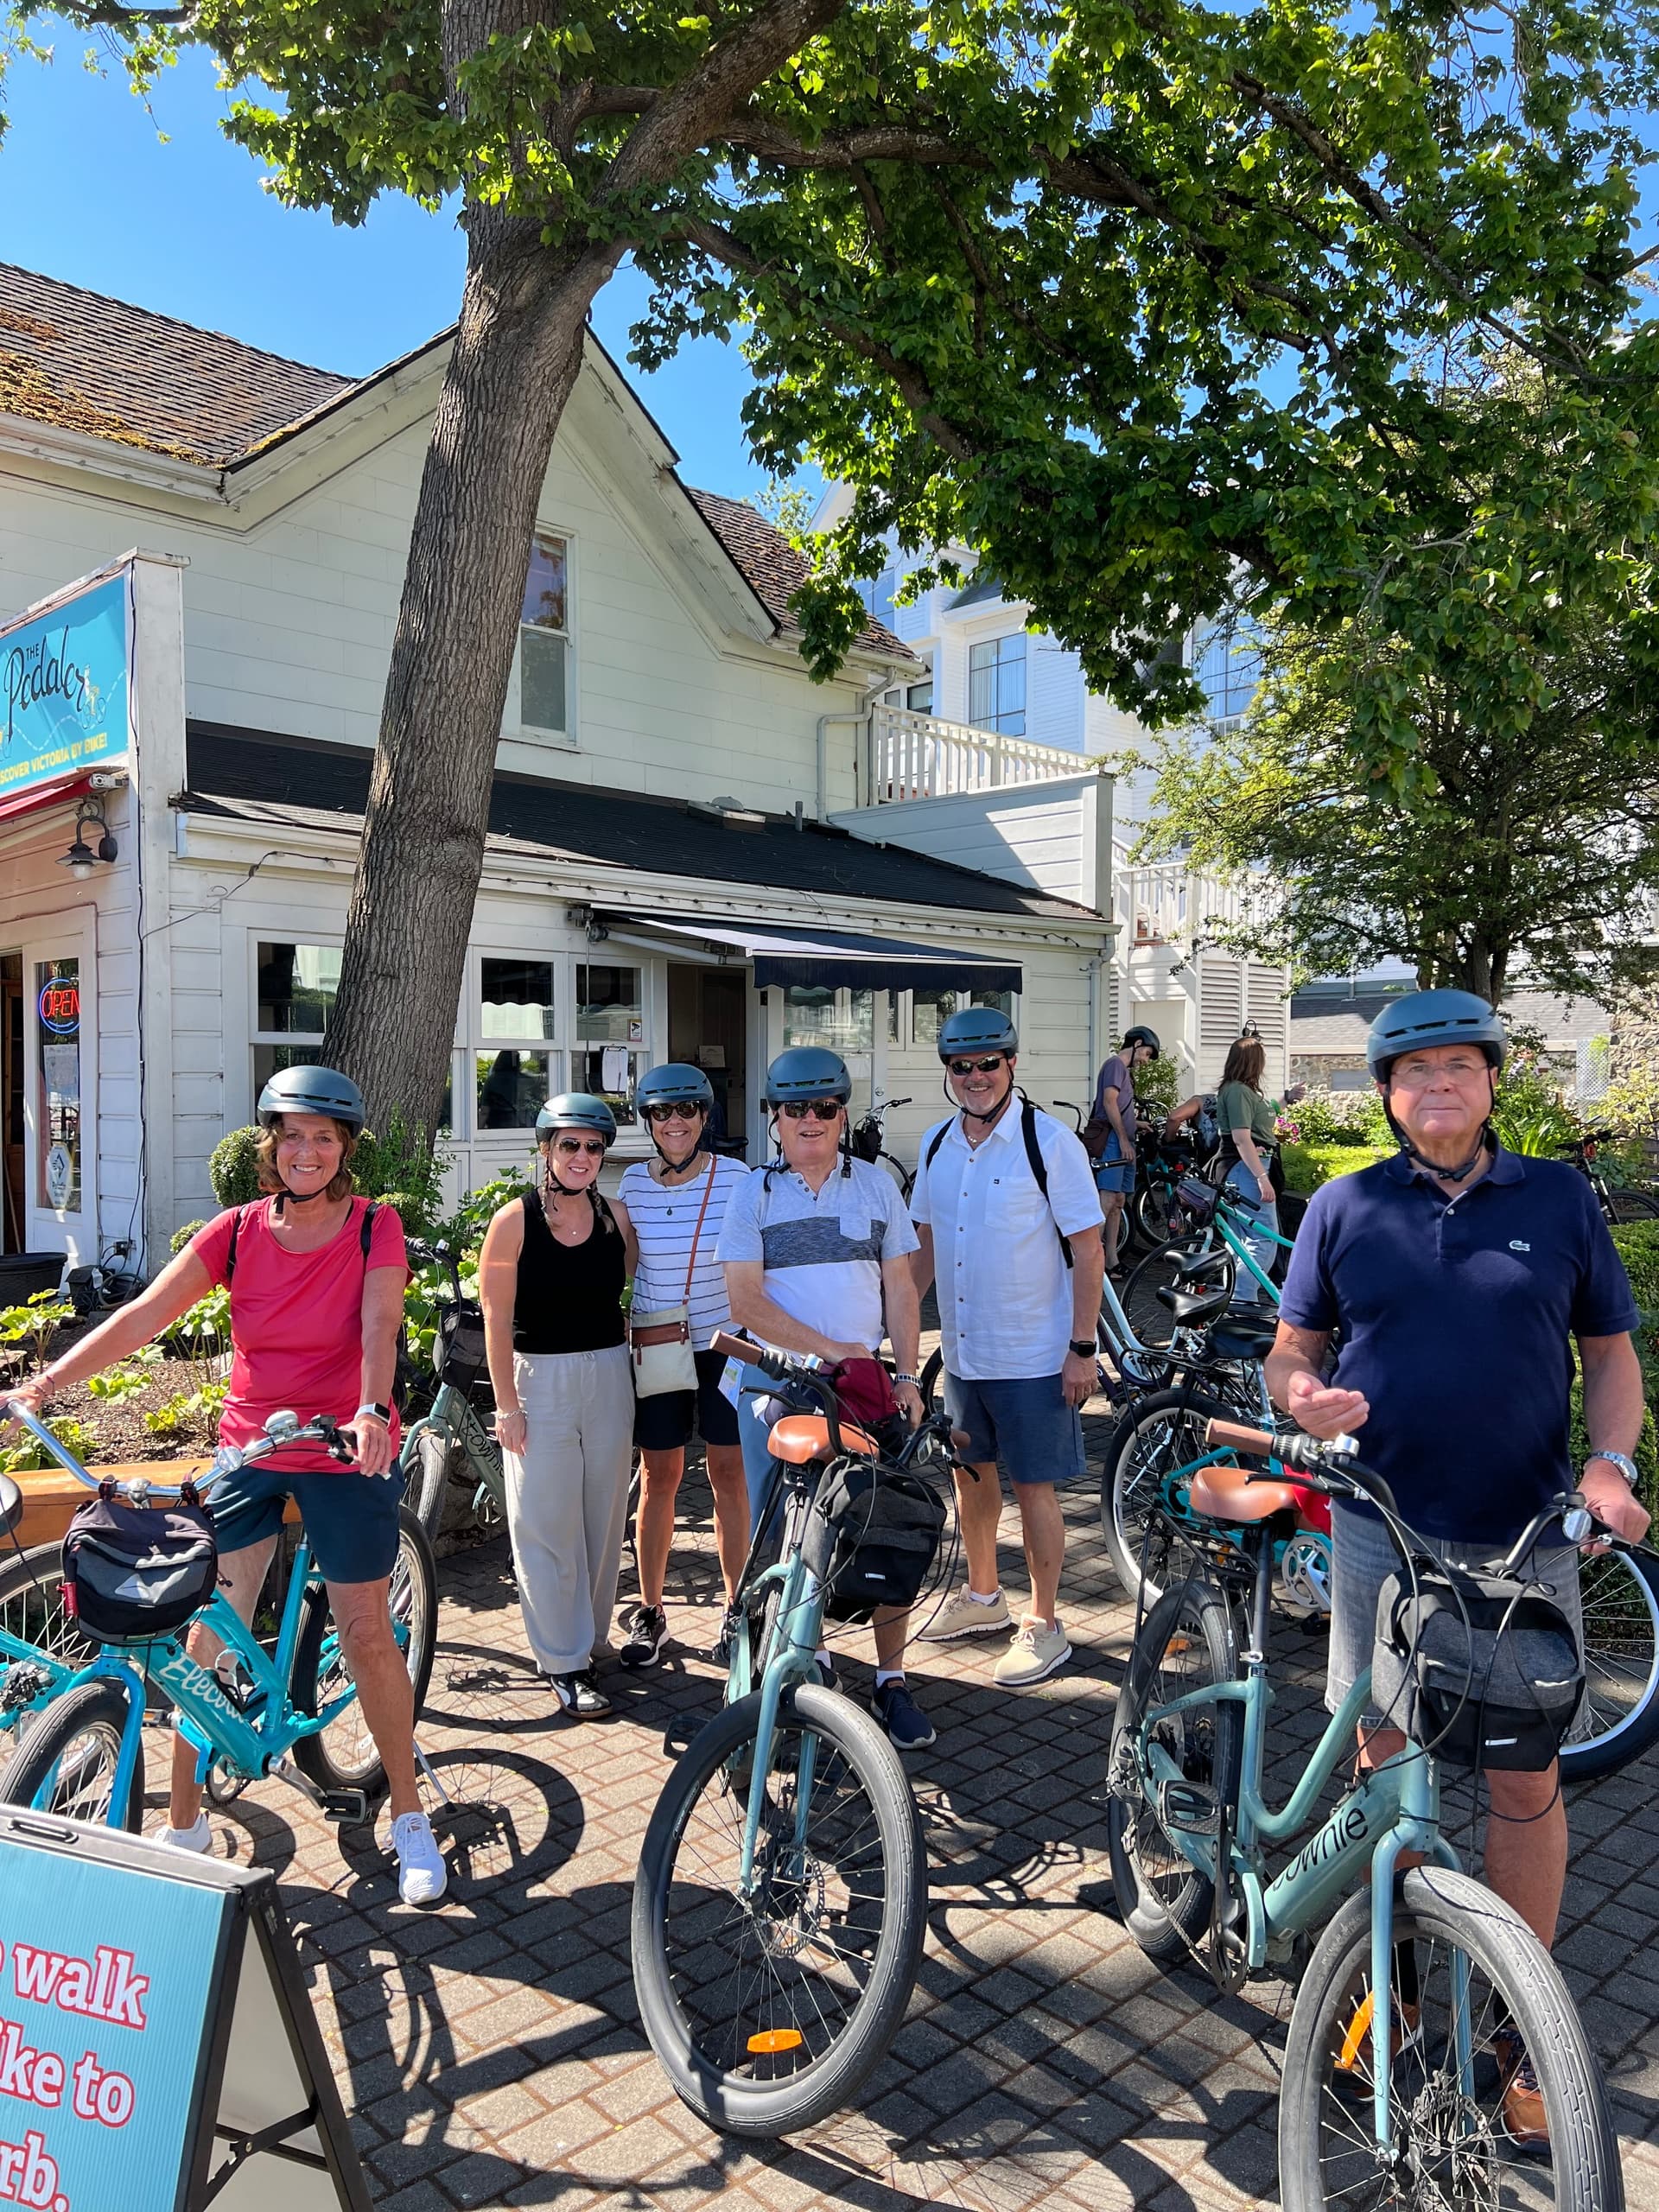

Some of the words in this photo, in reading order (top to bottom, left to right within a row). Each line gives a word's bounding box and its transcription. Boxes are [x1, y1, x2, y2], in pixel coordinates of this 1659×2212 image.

[26, 643, 40, 662] THE
[3, 624, 86, 744] Pedaler
[31, 747, 70, 772] VICTORIA
[71, 741, 82, 759] BY
[41, 988, 81, 1017] OPEN
[12, 1942, 149, 2031] walk
[73, 2050, 135, 2128] to
